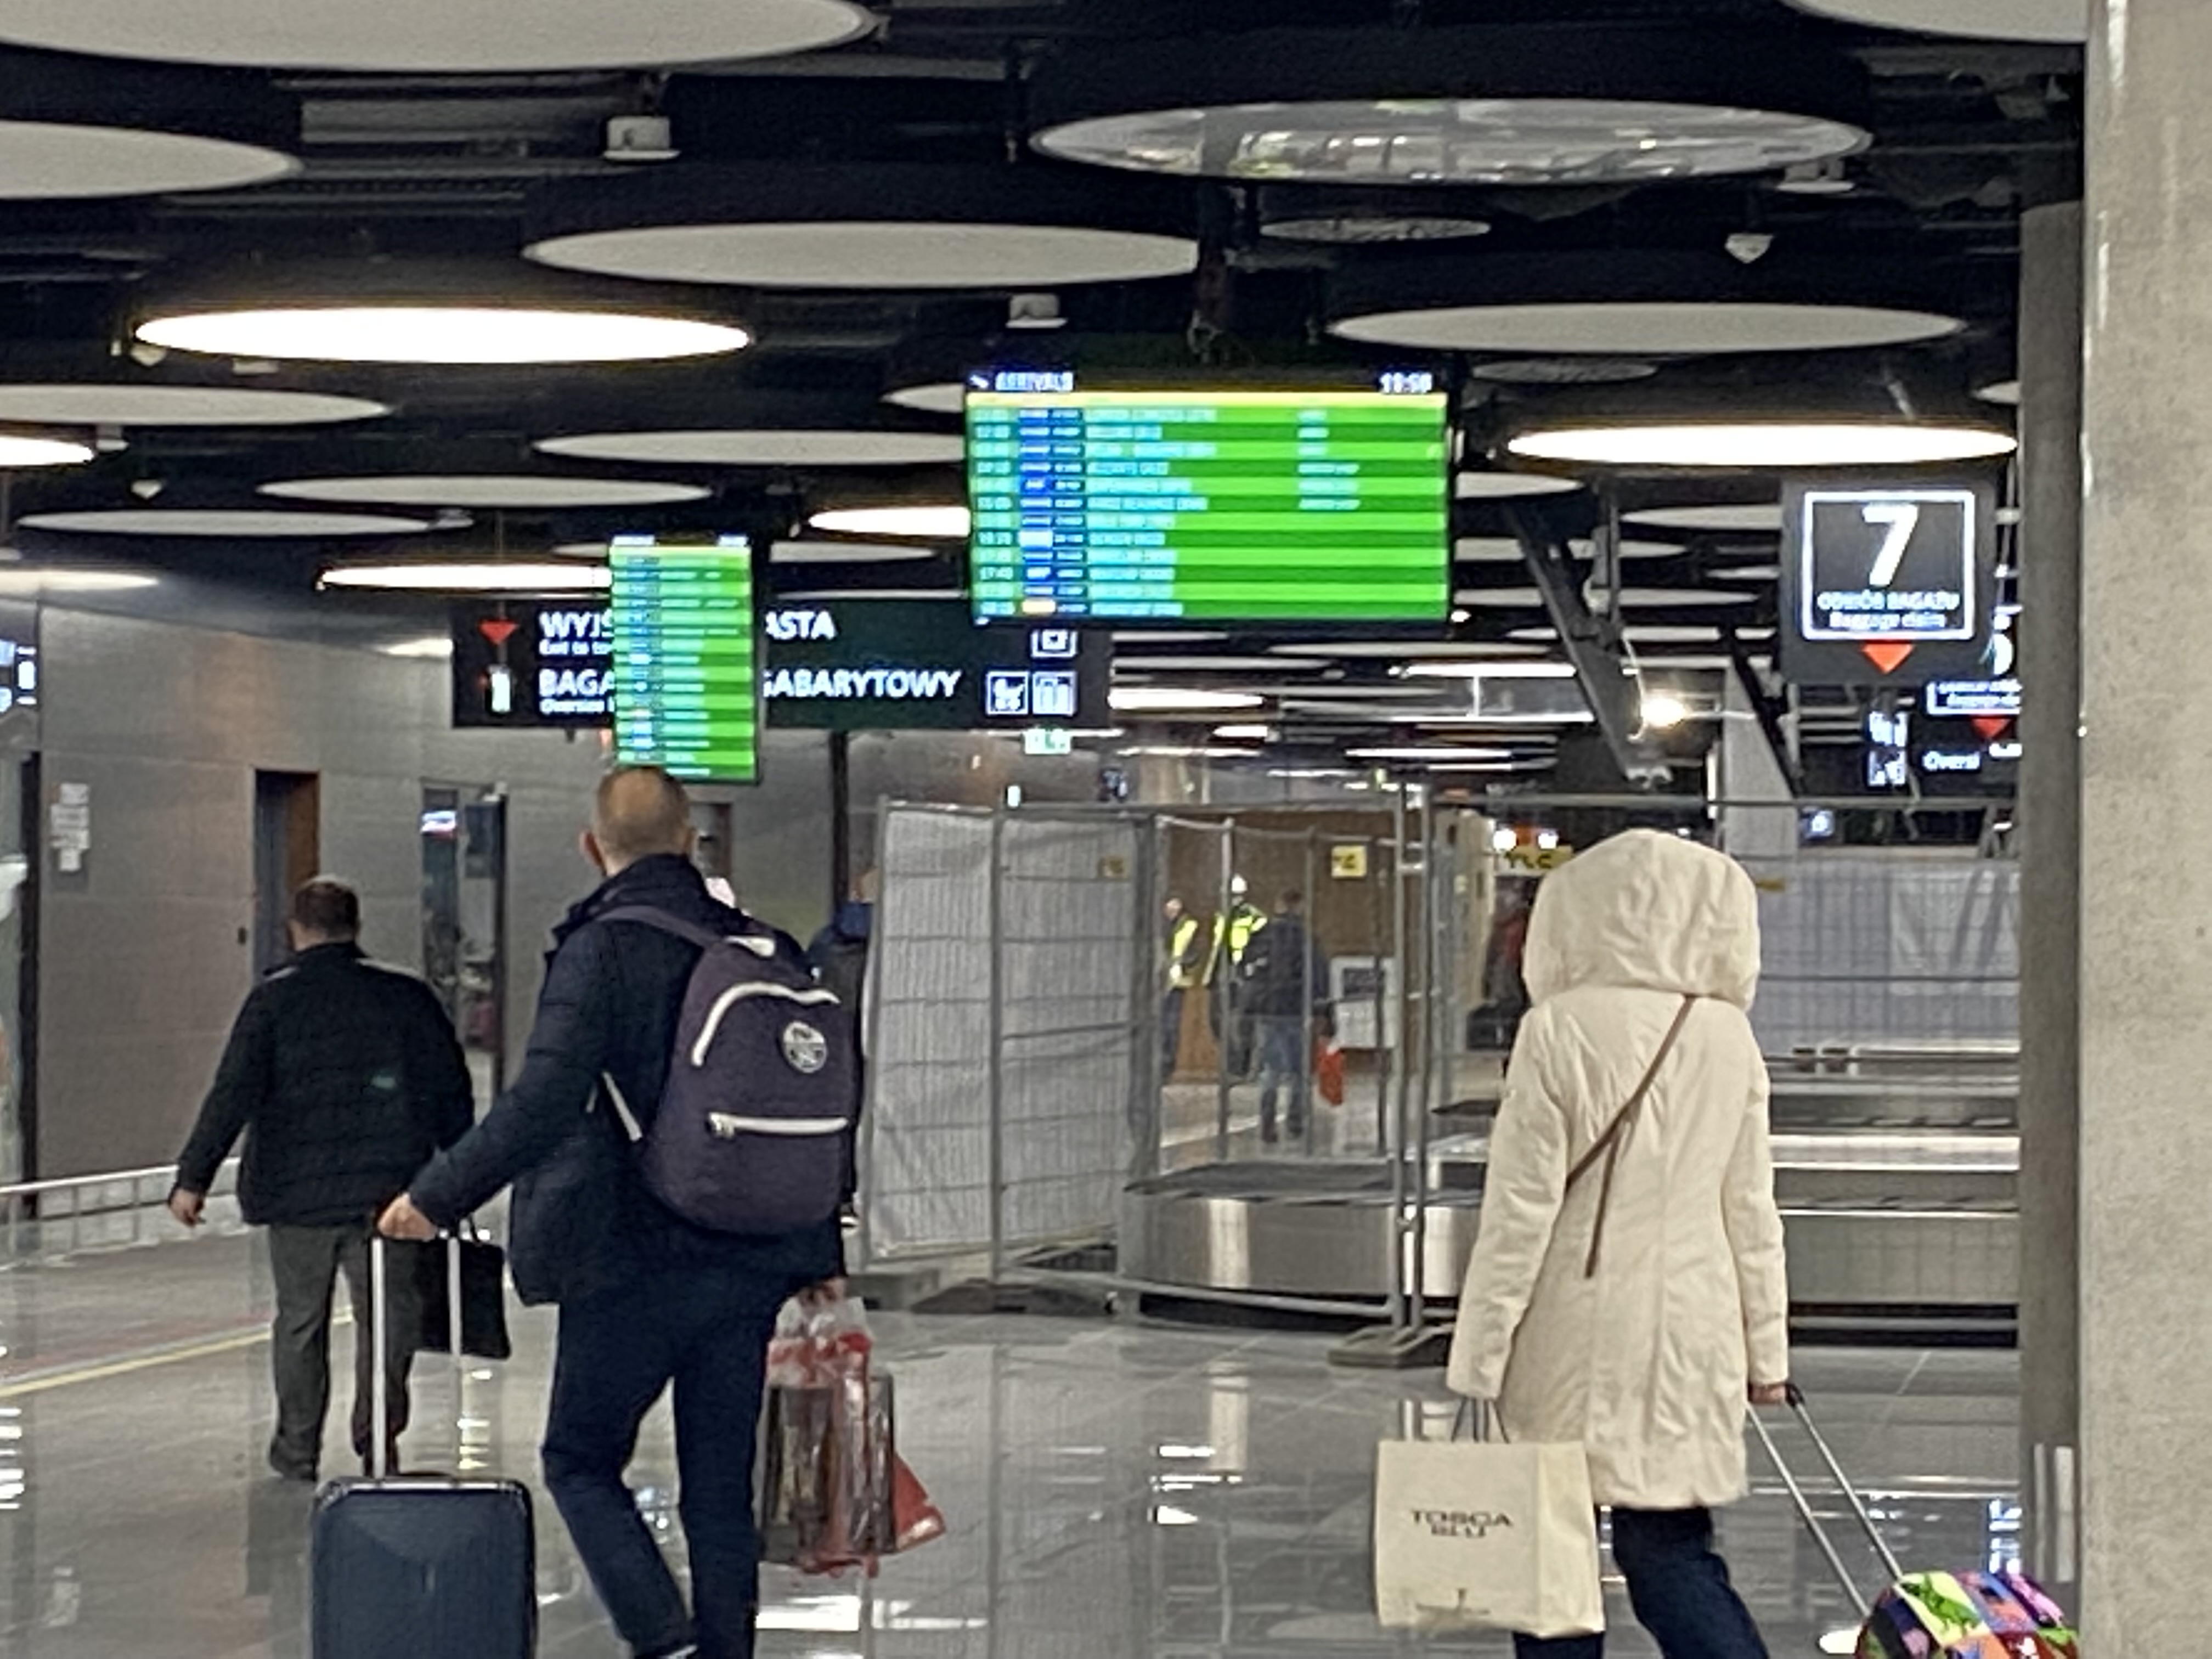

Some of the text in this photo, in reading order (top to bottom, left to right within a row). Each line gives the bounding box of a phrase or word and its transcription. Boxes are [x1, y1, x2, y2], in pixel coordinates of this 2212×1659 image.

[1863, 504, 1918, 586] 7
[765, 611, 837, 640] ASTA
[539, 668, 961, 698] BAGA ABARYTOWY
